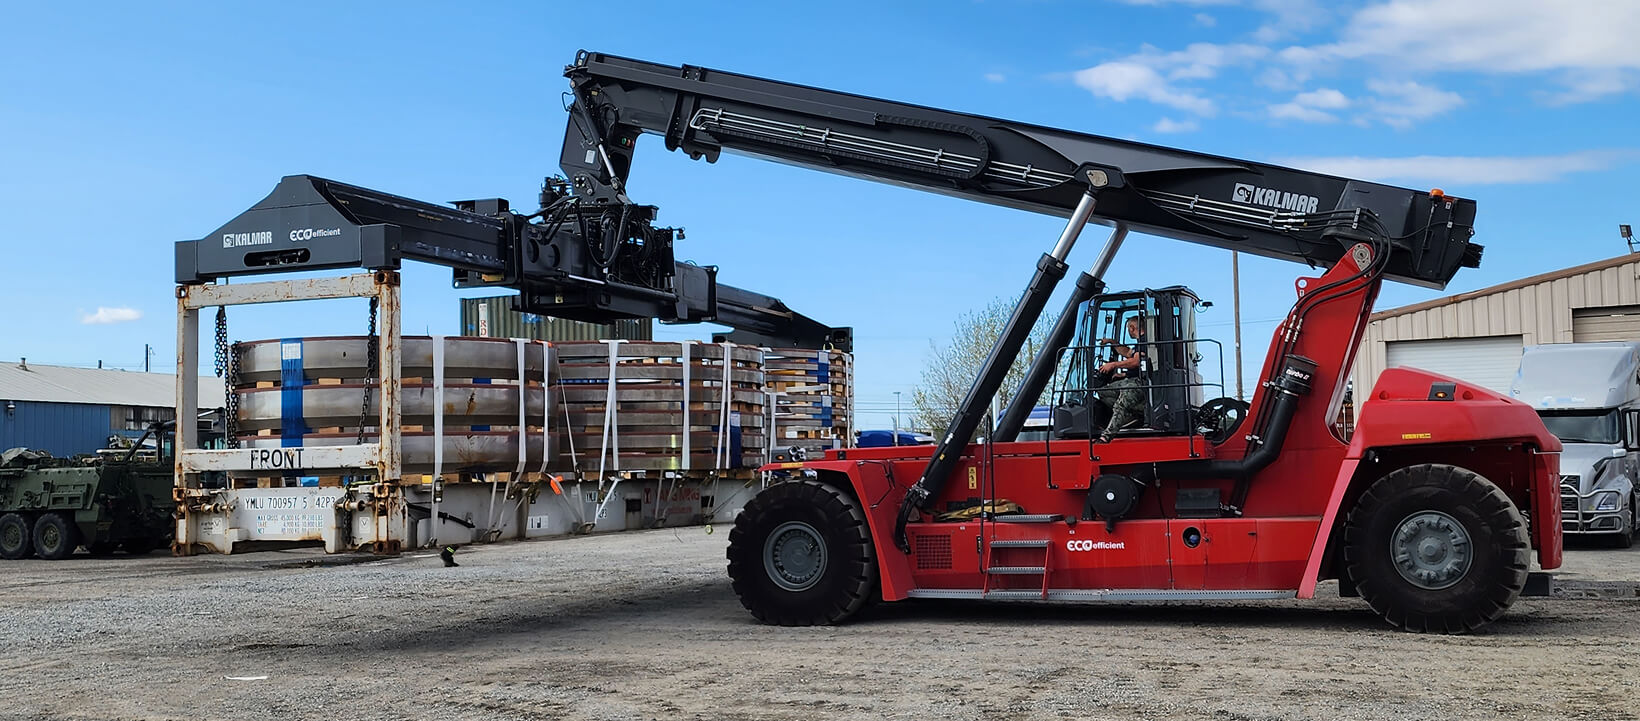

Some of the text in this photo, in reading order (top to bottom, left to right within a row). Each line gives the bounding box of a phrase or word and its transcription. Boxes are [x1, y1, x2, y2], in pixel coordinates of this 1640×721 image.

[1253, 187, 1319, 214] KALMAR
[235, 231, 272, 247] KALMAR
[250, 448, 305, 469] FRONT
[245, 497, 264, 509] YMLU
[268, 497, 297, 509] 700957
[302, 496, 308, 509] 5
